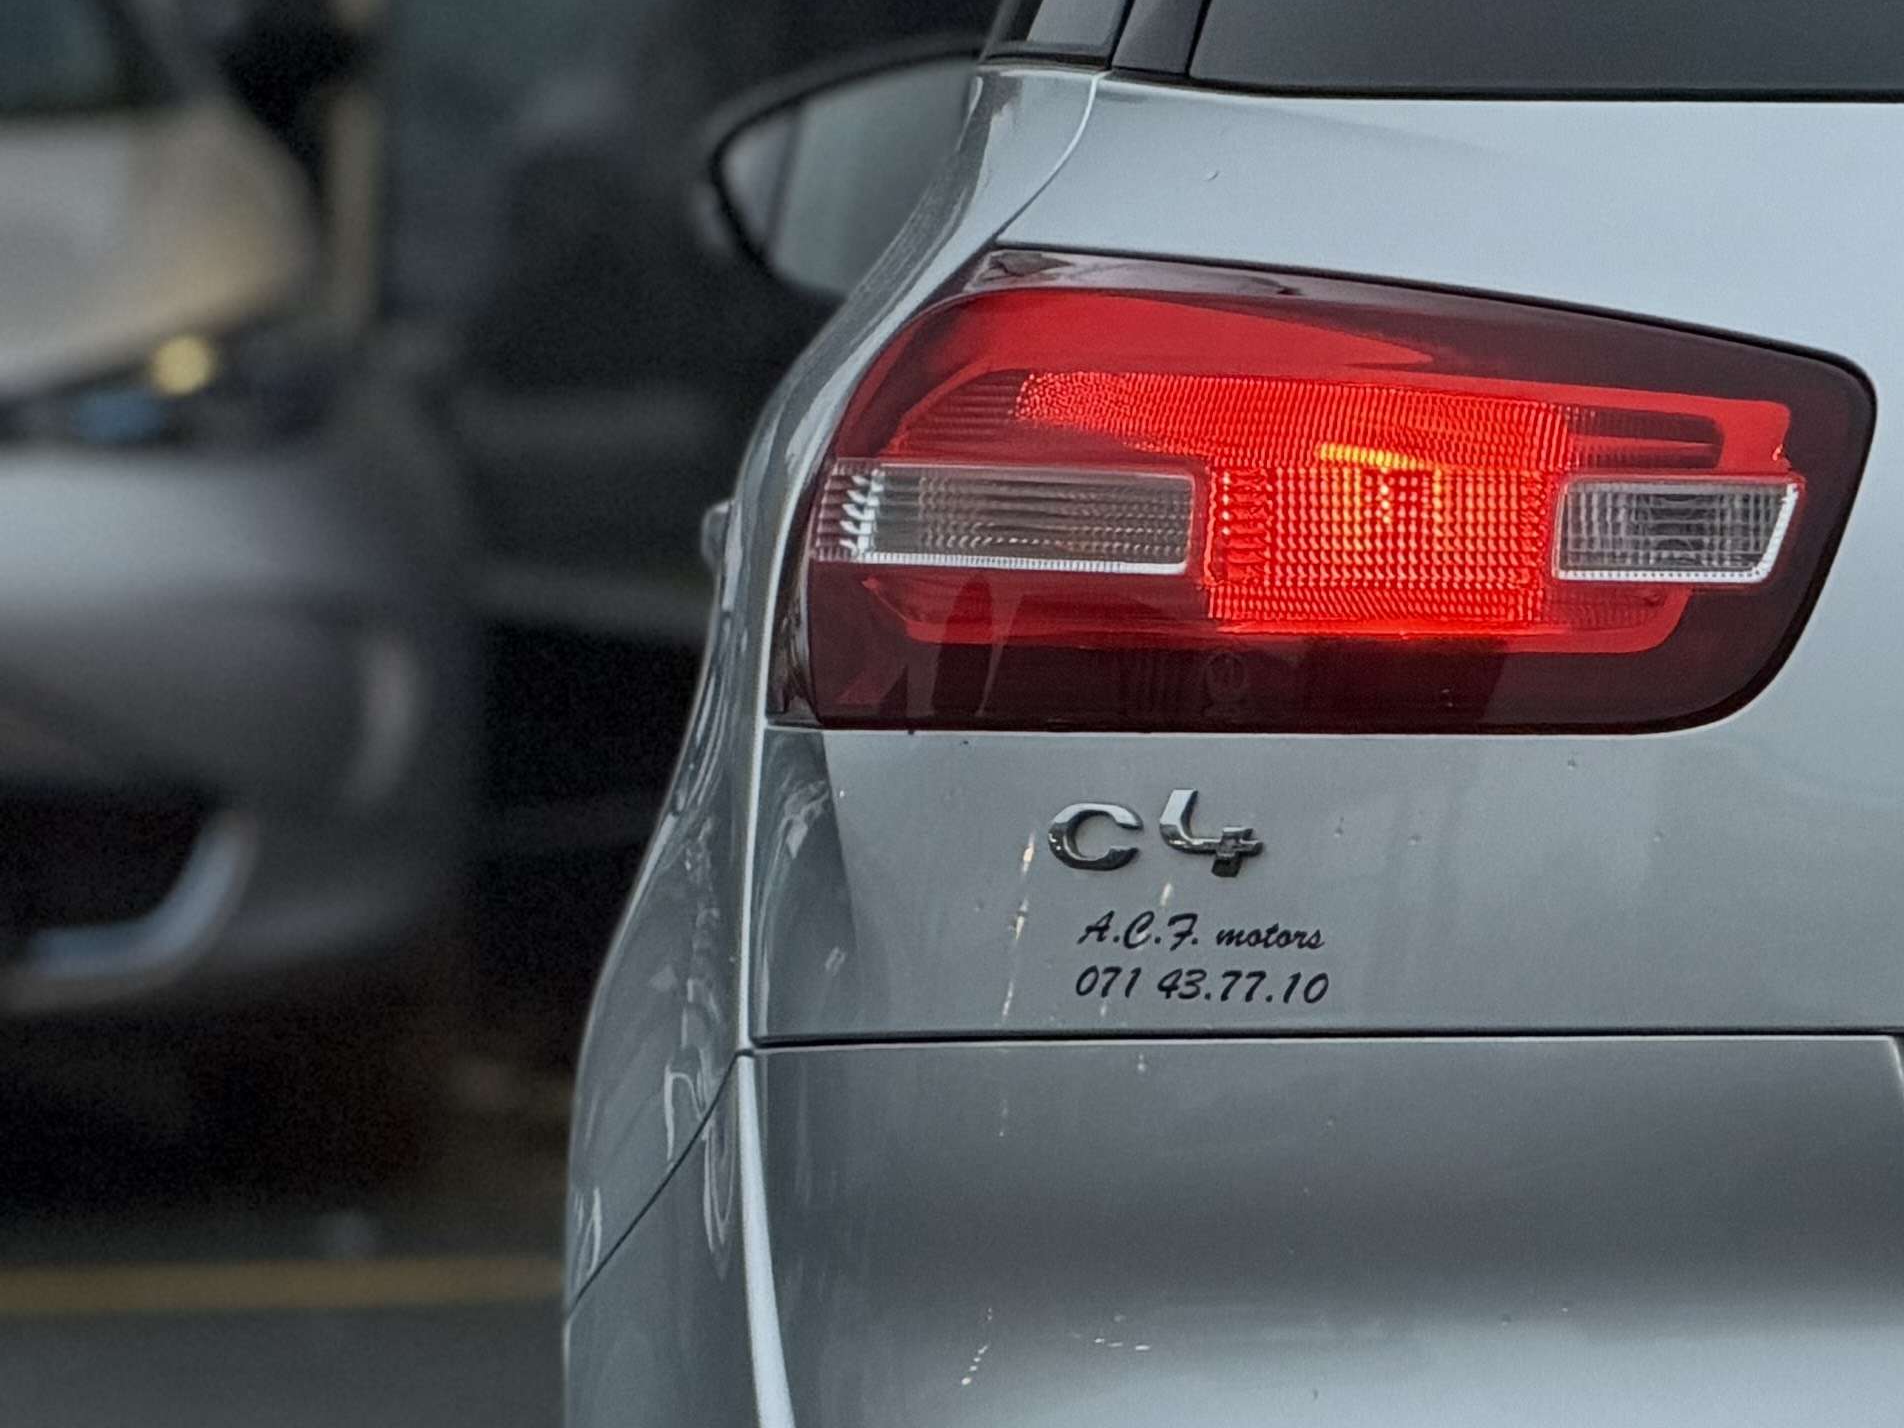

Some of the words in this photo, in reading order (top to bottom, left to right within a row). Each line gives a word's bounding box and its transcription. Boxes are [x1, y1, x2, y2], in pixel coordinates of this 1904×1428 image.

[1047, 788, 1264, 878] C4
[1216, 922, 1325, 950] motors
[1075, 966, 1142, 999] 071
[1157, 968, 1329, 1005] 43.77.10
